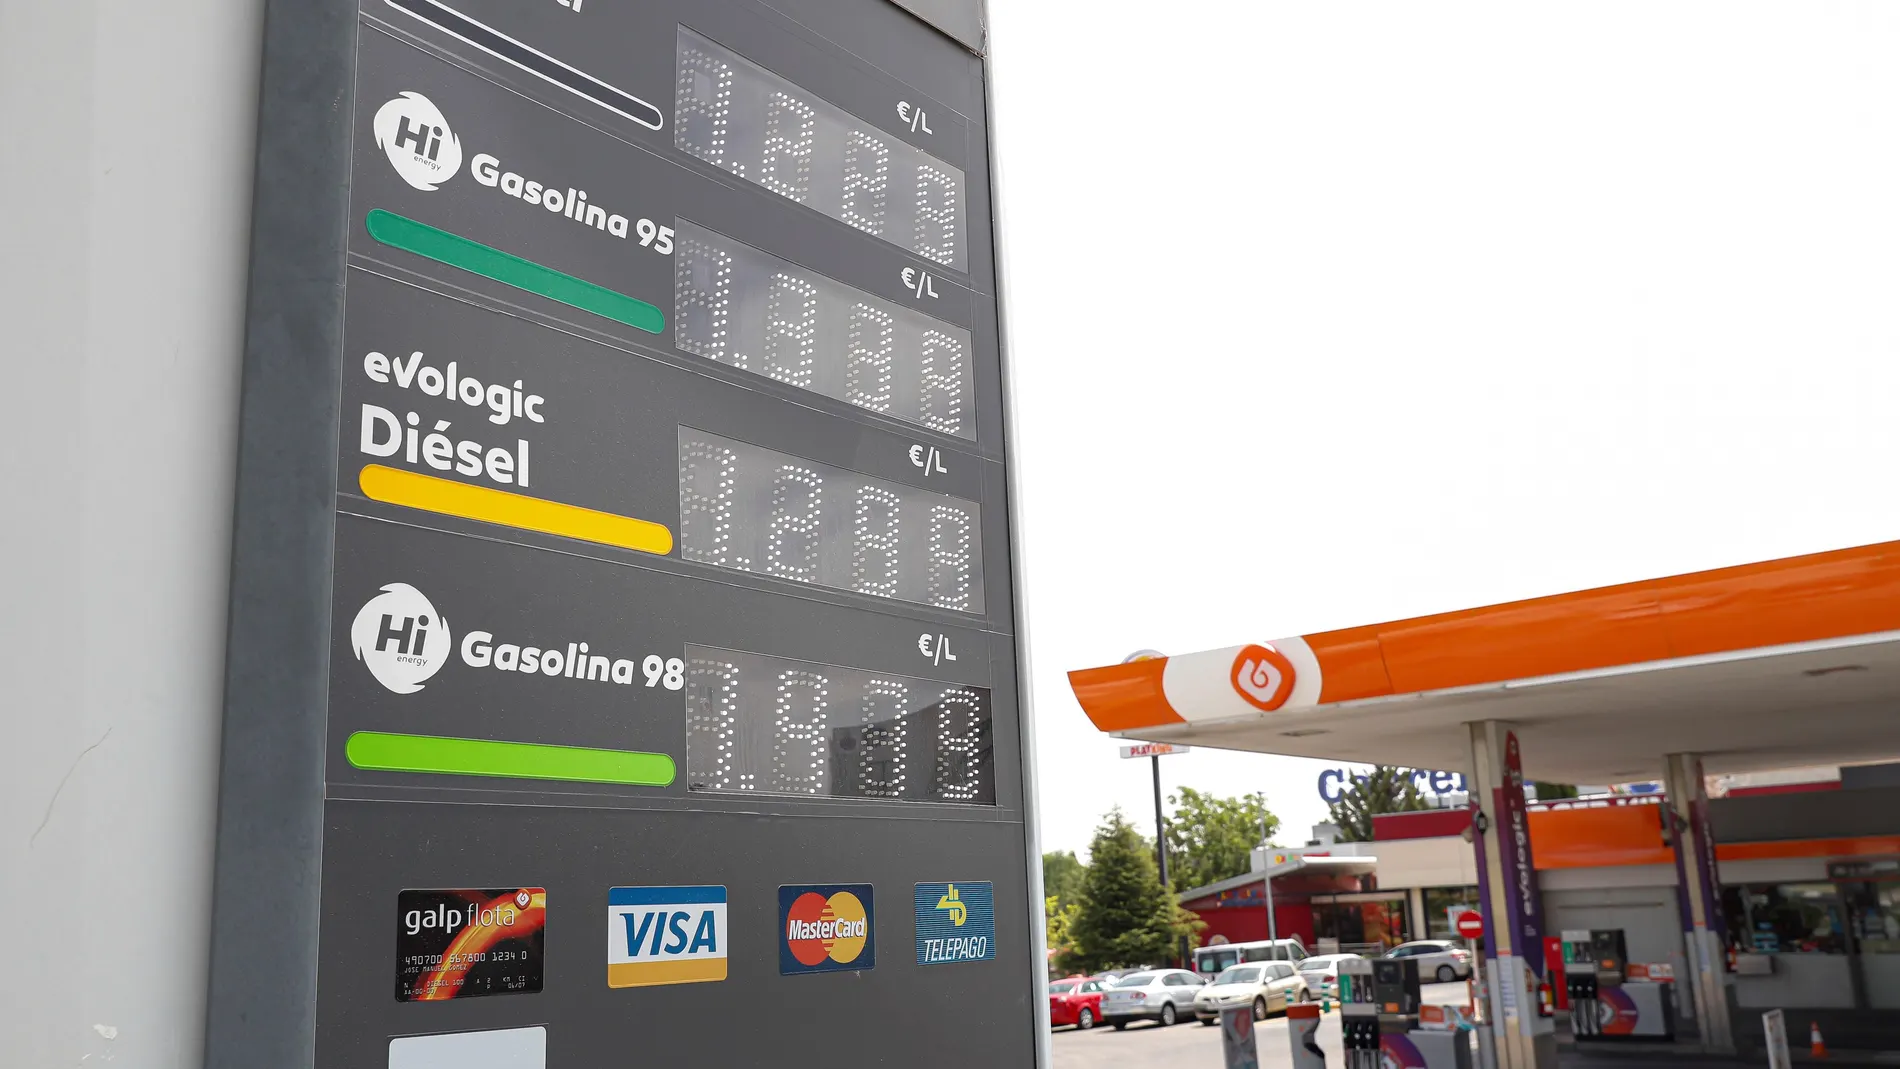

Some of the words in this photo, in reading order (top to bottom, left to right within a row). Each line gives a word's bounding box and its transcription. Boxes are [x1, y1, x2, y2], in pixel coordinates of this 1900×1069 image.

[896, 100, 933, 135] €/L
[394, 115, 443, 161] Hi
[413, 154, 442, 171] energy
[709, 63, 955, 264] 1.229
[471, 153, 629, 239] Gasolina
[636, 218, 675, 255] 95
[900, 267, 939, 299] €/L
[710, 251, 962, 434] 1.339
[360, 403, 529, 488] Diésel
[908, 444, 947, 476] €/L
[713, 448, 970, 610] 1.299
[375, 613, 429, 656] Hi
[917, 633, 957, 666] €/L
[396, 654, 428, 667] energy
[461, 630, 634, 685] Gasolina
[642, 655, 684, 691] 98
[715, 662, 980, 799] 1.479
[405, 903, 462, 935] galp
[467, 903, 515, 927] flota
[619, 910, 717, 957] VISA
[788, 917, 867, 941] MasterCard
[405, 954, 443, 966] 490700
[449, 952, 486, 964] 567800
[492, 951, 516, 962] 1234
[924, 935, 987, 963] TELEPAGO
[404, 966, 419, 974] JOSE
